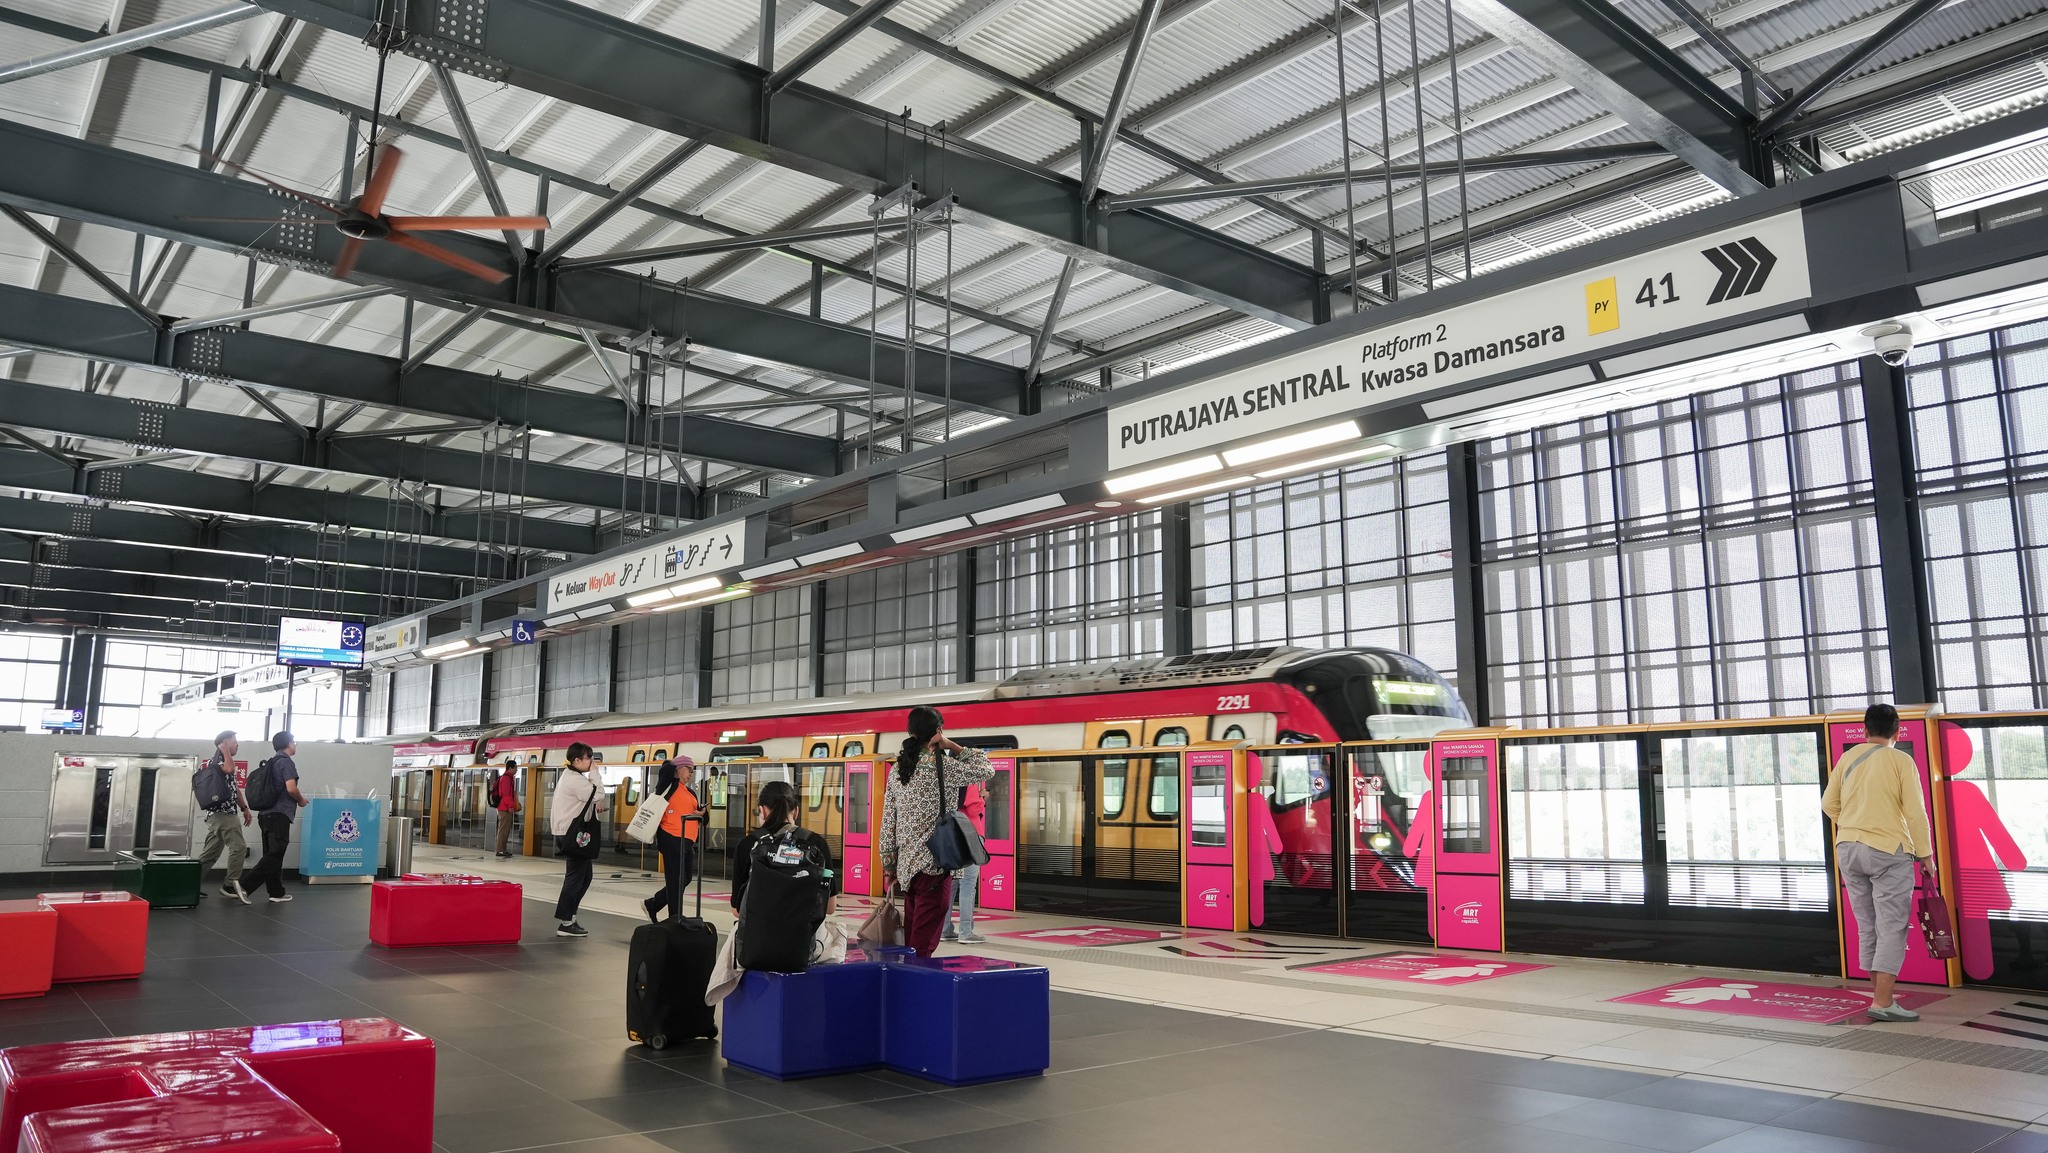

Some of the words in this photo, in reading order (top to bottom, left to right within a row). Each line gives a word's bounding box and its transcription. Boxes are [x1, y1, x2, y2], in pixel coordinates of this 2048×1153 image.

[1635, 271, 1680, 309] 41
[1593, 299, 1610, 315] PY
[1361, 331, 1432, 363] Platform
[1435, 323, 1447, 343] 2
[1361, 361, 1428, 393] Kwasa
[1434, 324, 1566, 374] Damansara
[1120, 394, 1240, 449] PUTRAJAYA
[1242, 364, 1350, 416] SENTRAL
[566, 581, 588, 597] Keluar
[588, 576, 603, 592] Way
[603, 572, 616, 587] Out
[1216, 694, 1251, 711] 2291
[1205, 893, 1218, 901] MRT
[1462, 908, 1479, 917] MRT
